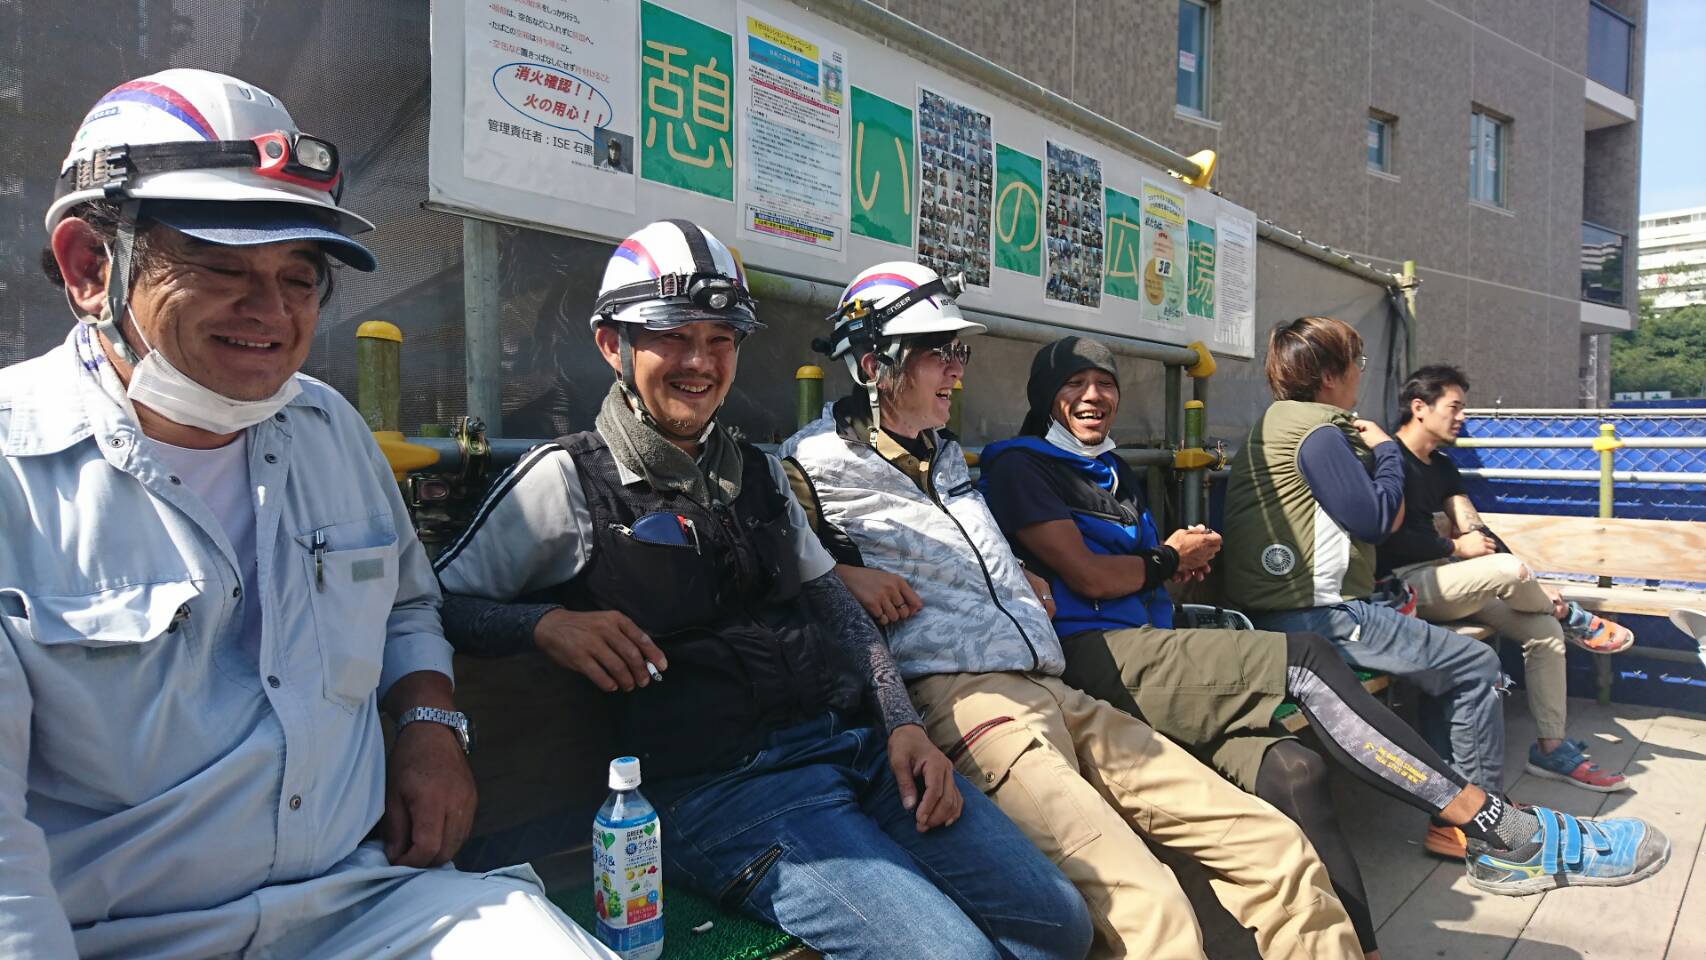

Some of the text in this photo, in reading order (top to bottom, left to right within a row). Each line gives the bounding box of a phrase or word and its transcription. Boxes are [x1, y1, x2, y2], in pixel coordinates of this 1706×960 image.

[523, 93, 603, 127] 火の用心！！
[643, 39, 732, 169] 憩
[855, 121, 910, 216] い
[996, 181, 1040, 252] の
[1105, 210, 1141, 286] 広
[1187, 238, 1216, 305] 場
[1474, 792, 1502, 833] Find
